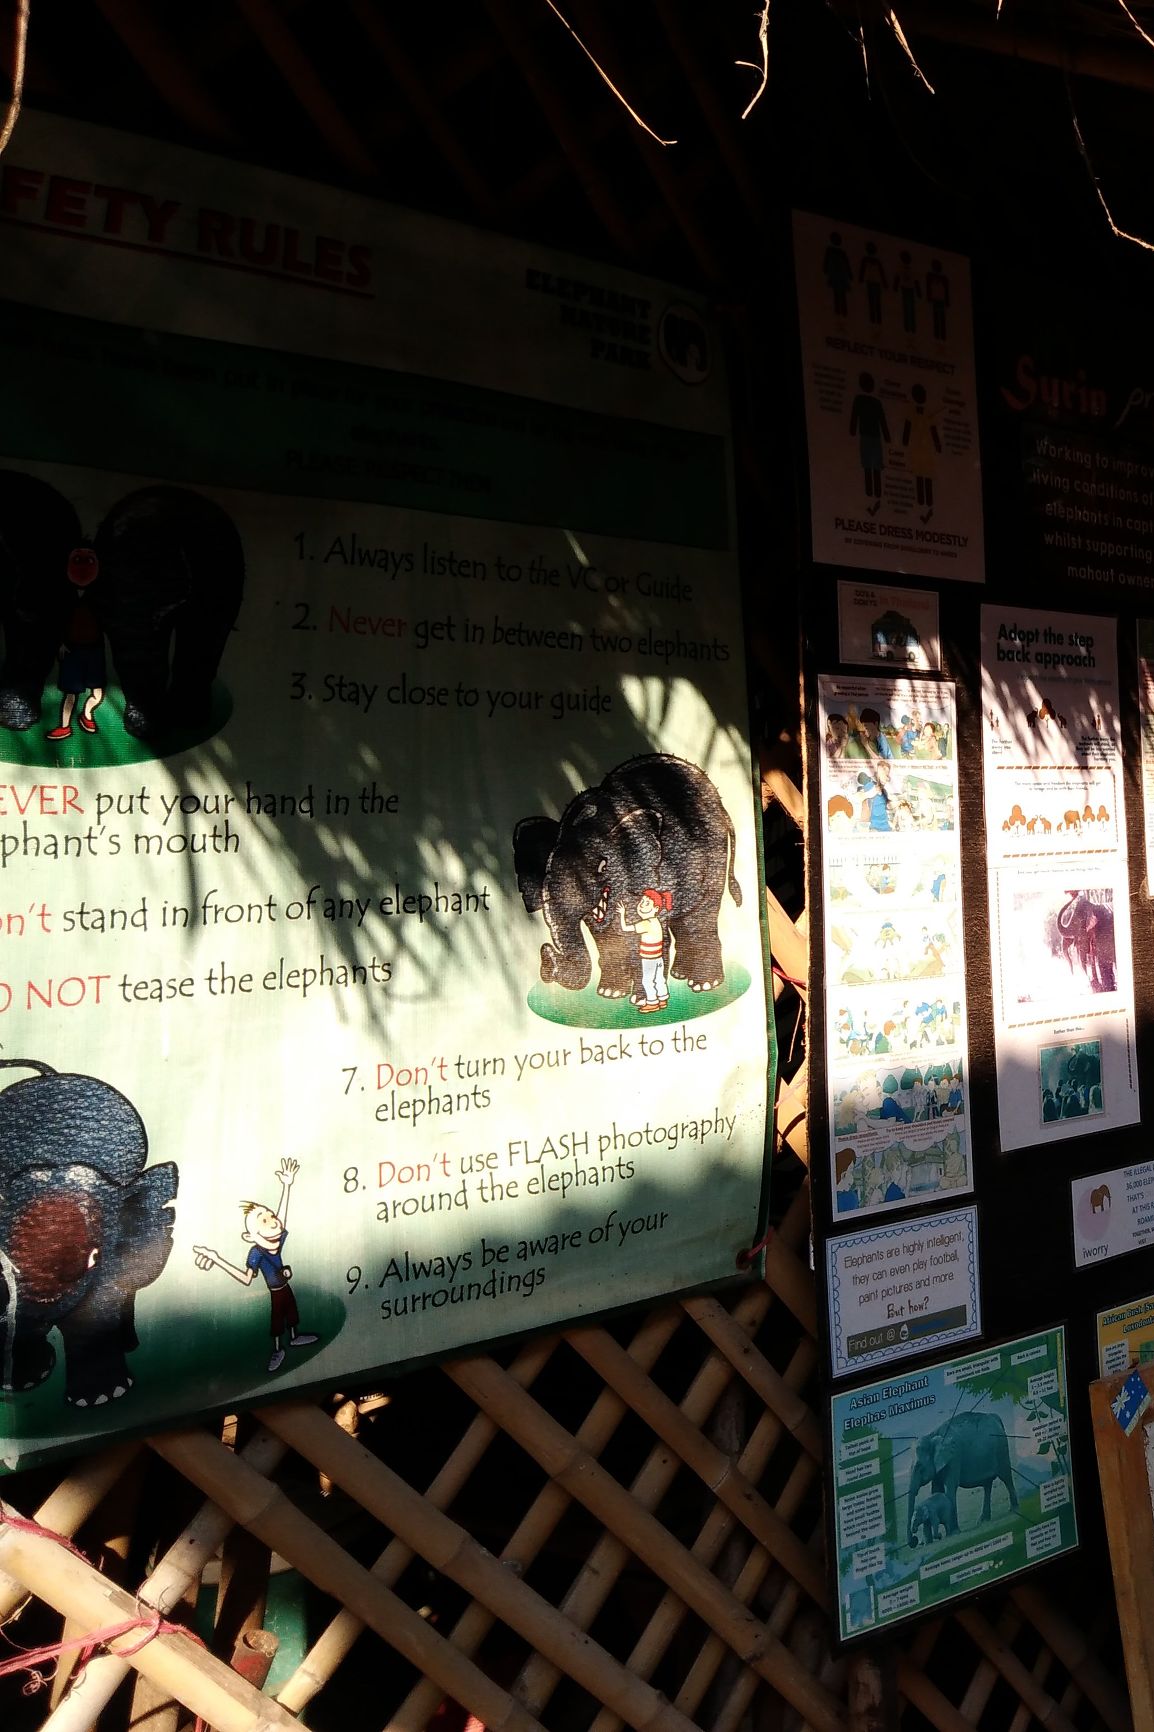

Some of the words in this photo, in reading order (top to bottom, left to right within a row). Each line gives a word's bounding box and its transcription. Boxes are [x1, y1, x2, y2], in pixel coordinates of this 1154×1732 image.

[2, 165, 182, 245] FETY
[197, 207, 372, 287] RULES
[1036, 436, 1092, 468] Working
[1096, 452, 1109, 468] to
[1033, 468, 1070, 493] living
[1074, 479, 1138, 503] conditions
[1142, 492, 1153, 506] of
[1045, 500, 1109, 526] elephants
[1112, 513, 1121, 527] in
[835, 517, 876, 535] PLEASE
[880, 524, 912, 539] DRESS
[916, 529, 968, 548] MODESTLY
[1044, 531, 1081, 549] whilst
[1086, 538, 1153, 563] supporting
[294, 532, 315, 561] 1.
[324, 533, 414, 579] Always
[424, 542, 486, 581] listen
[494, 555, 522, 583] to
[528, 556, 560, 586] the
[566, 567, 599, 592] VC
[606, 573, 629, 592] or
[635, 572, 692, 603] Guide
[1067, 564, 1115, 582] mahout
[292, 603, 317, 631] 2.
[328, 605, 407, 637] Never
[415, 615, 455, 648] get
[465, 619, 484, 643] in
[493, 619, 583, 652] between
[590, 630, 632, 653] two
[638, 630, 730, 664] elephants
[998, 623, 1040, 645] Adopt
[1044, 627, 1064, 645] the
[1068, 633, 1094, 648] step
[997, 643, 1030, 663] back
[1035, 651, 1095, 669] approach
[290, 672, 313, 700] 3.
[322, 673, 378, 712] Stay
[387, 673, 448, 706] close
[455, 681, 479, 706] to
[486, 687, 544, 719] your
[551, 683, 612, 717] guide
[0, 785, 85, 816] VER
[95, 787, 151, 825] put
[162, 793, 235, 825] your
[245, 781, 315, 818] hand
[326, 788, 350, 816] in
[358, 782, 400, 814] the
[134, 820, 240, 855] mouth
[0, 902, 52, 936] n't
[62, 897, 148, 932] stand
[162, 899, 189, 928] in
[202, 888, 277, 926] front
[285, 885, 321, 920] of
[322, 891, 371, 927] any
[379, 880, 490, 924] elephant
[26, 975, 111, 1012] NOT
[118, 975, 195, 1002] tease
[209, 960, 252, 995] the
[262, 955, 392, 998] elephants
[341, 1067, 365, 1096] 7.
[376, 1056, 448, 1090] Don't
[454, 1054, 505, 1079] turn
[514, 1049, 571, 1081] your
[580, 1037, 632, 1065] back
[637, 1034, 664, 1057] to
[671, 1025, 708, 1053] the
[375, 1084, 491, 1126] elephants
[343, 1166, 366, 1193] 8.
[378, 1152, 451, 1188] Don't
[459, 1149, 498, 1174] use
[508, 1131, 590, 1168] FLASH
[598, 1107, 736, 1156] photography
[1123, 1170, 1132, 1178] THE
[1133, 1165, 1152, 1176] ILLEGAL
[376, 1179, 468, 1223] around
[477, 1173, 518, 1203] the
[527, 1157, 635, 1198] elephants
[346, 1266, 369, 1294] 9.
[379, 1251, 472, 1287] Always
[481, 1238, 510, 1267] be
[516, 1231, 581, 1259] aware
[588, 1210, 618, 1245] of
[618, 1211, 668, 1246] your
[844, 1250, 884, 1269] Elephants
[887, 1247, 900, 1258] are
[903, 1240, 924, 1256] highly
[1082, 1244, 1109, 1259] iworry
[853, 1274, 869, 1286] they
[873, 1269, 887, 1281] can
[890, 1263, 910, 1277] even
[913, 1258, 927, 1273] play
[859, 1290, 878, 1306] paint
[881, 1281, 913, 1301] pictures
[915, 1276, 930, 1289] and
[933, 1272, 954, 1284] more
[381, 1265, 545, 1320] surroundings
[887, 1303, 904, 1319] But
[908, 1296, 929, 1314] how?
[848, 1338, 866, 1351] Find
[870, 1334, 882, 1346] out
[850, 1393, 879, 1410] Asian
[882, 1376, 929, 1399] Elephant
[844, 1410, 887, 1430] Elephas
[889, 1394, 936, 1417] Maximus
